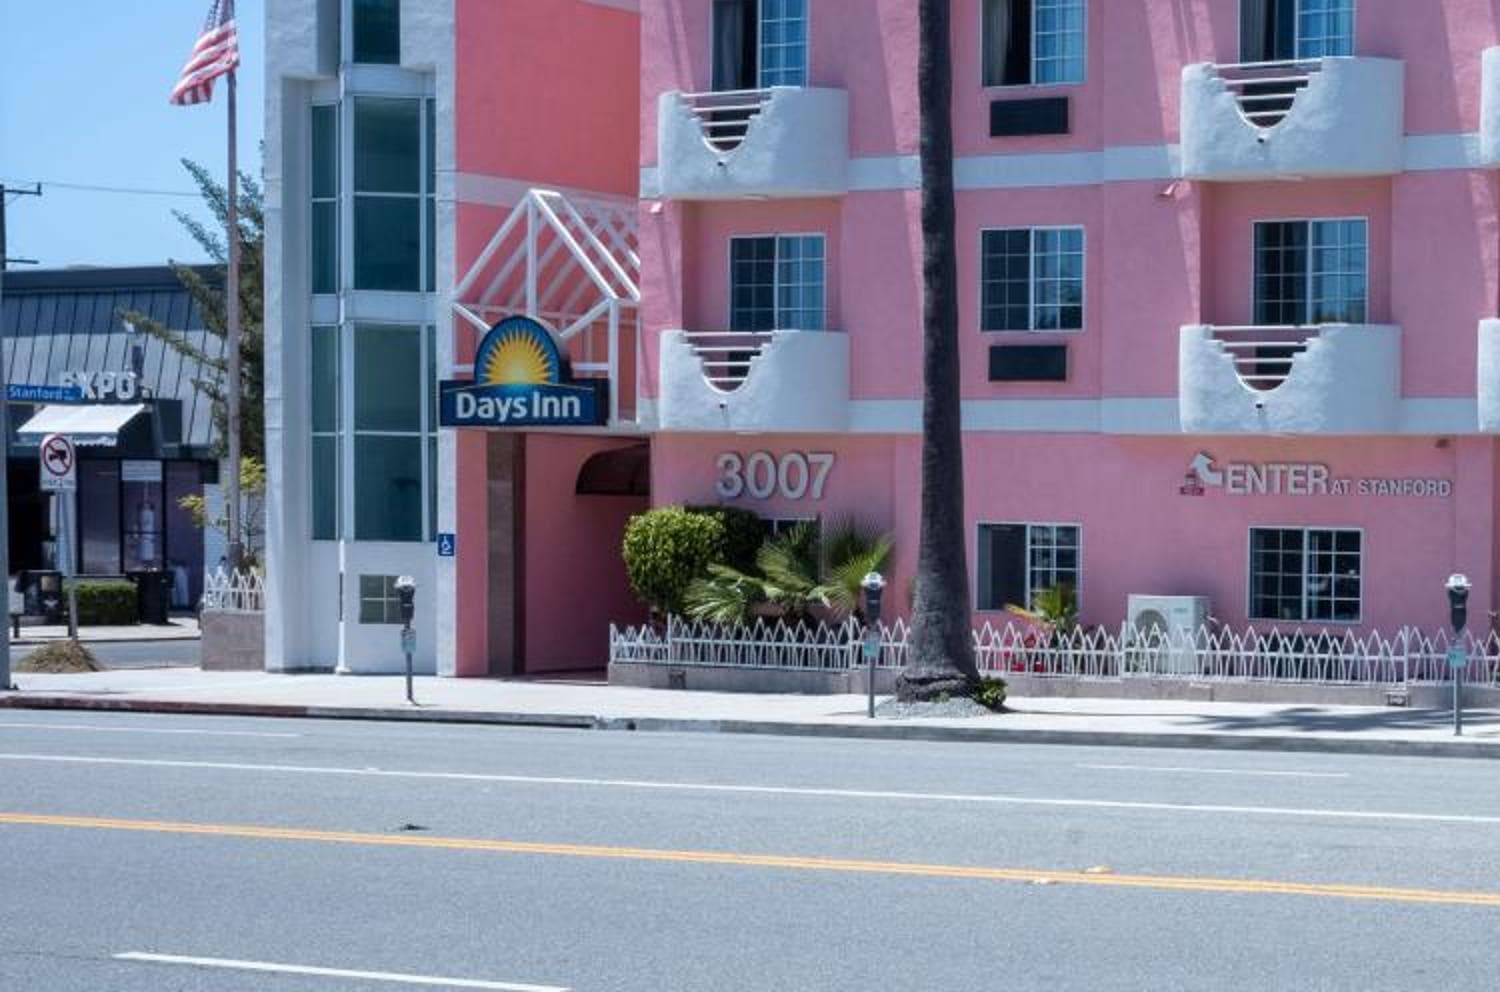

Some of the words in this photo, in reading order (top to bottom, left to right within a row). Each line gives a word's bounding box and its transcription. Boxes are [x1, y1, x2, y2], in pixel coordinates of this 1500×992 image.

[9, 385, 62, 401] Stanford
[456, 392, 528, 422] Days
[533, 391, 581, 417] Inn
[715, 451, 834, 499] 3007
[1226, 463, 1329, 495] ENTER
[1330, 479, 1352, 496] AT
[1357, 479, 1451, 497] STANFORD
